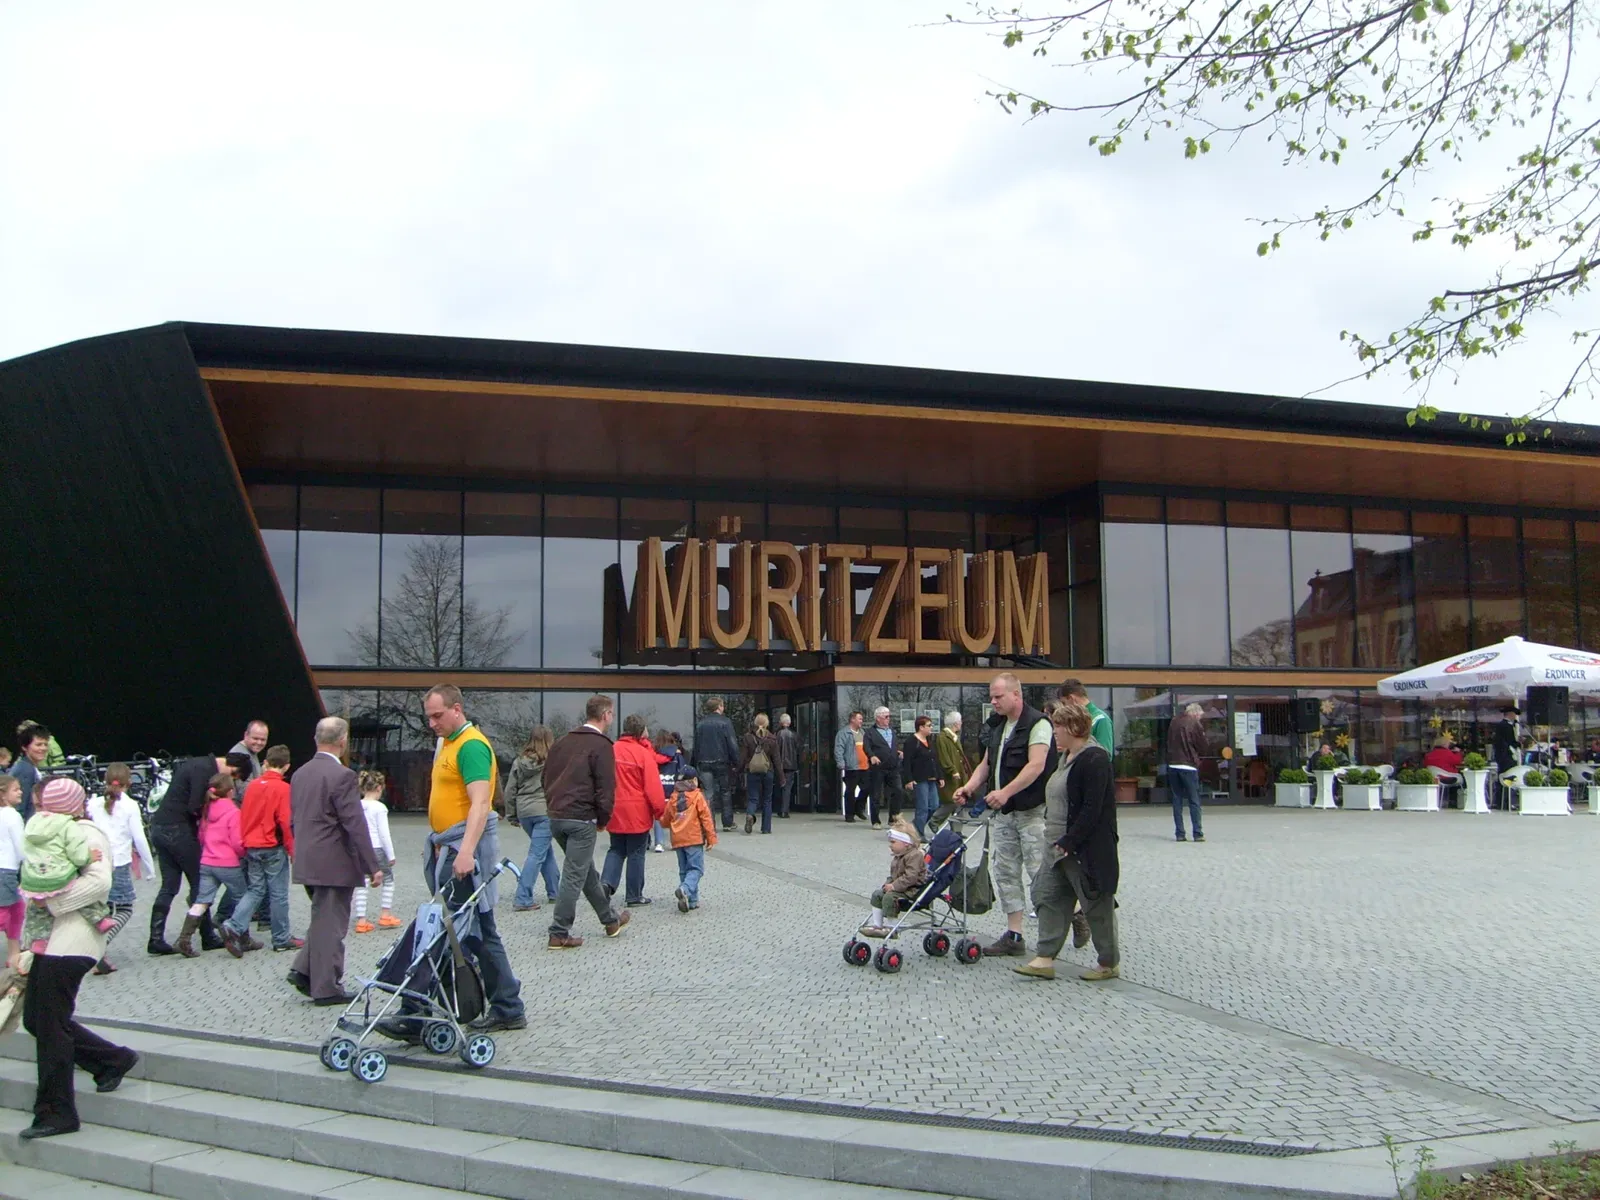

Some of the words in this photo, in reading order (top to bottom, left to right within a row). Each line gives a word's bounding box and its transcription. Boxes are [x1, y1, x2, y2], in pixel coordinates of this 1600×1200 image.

[637, 515, 1050, 655] MÜRITZEUM
[1545, 669, 1586, 680] ERDINGER
[1394, 680, 1428, 691] ERDINGER
